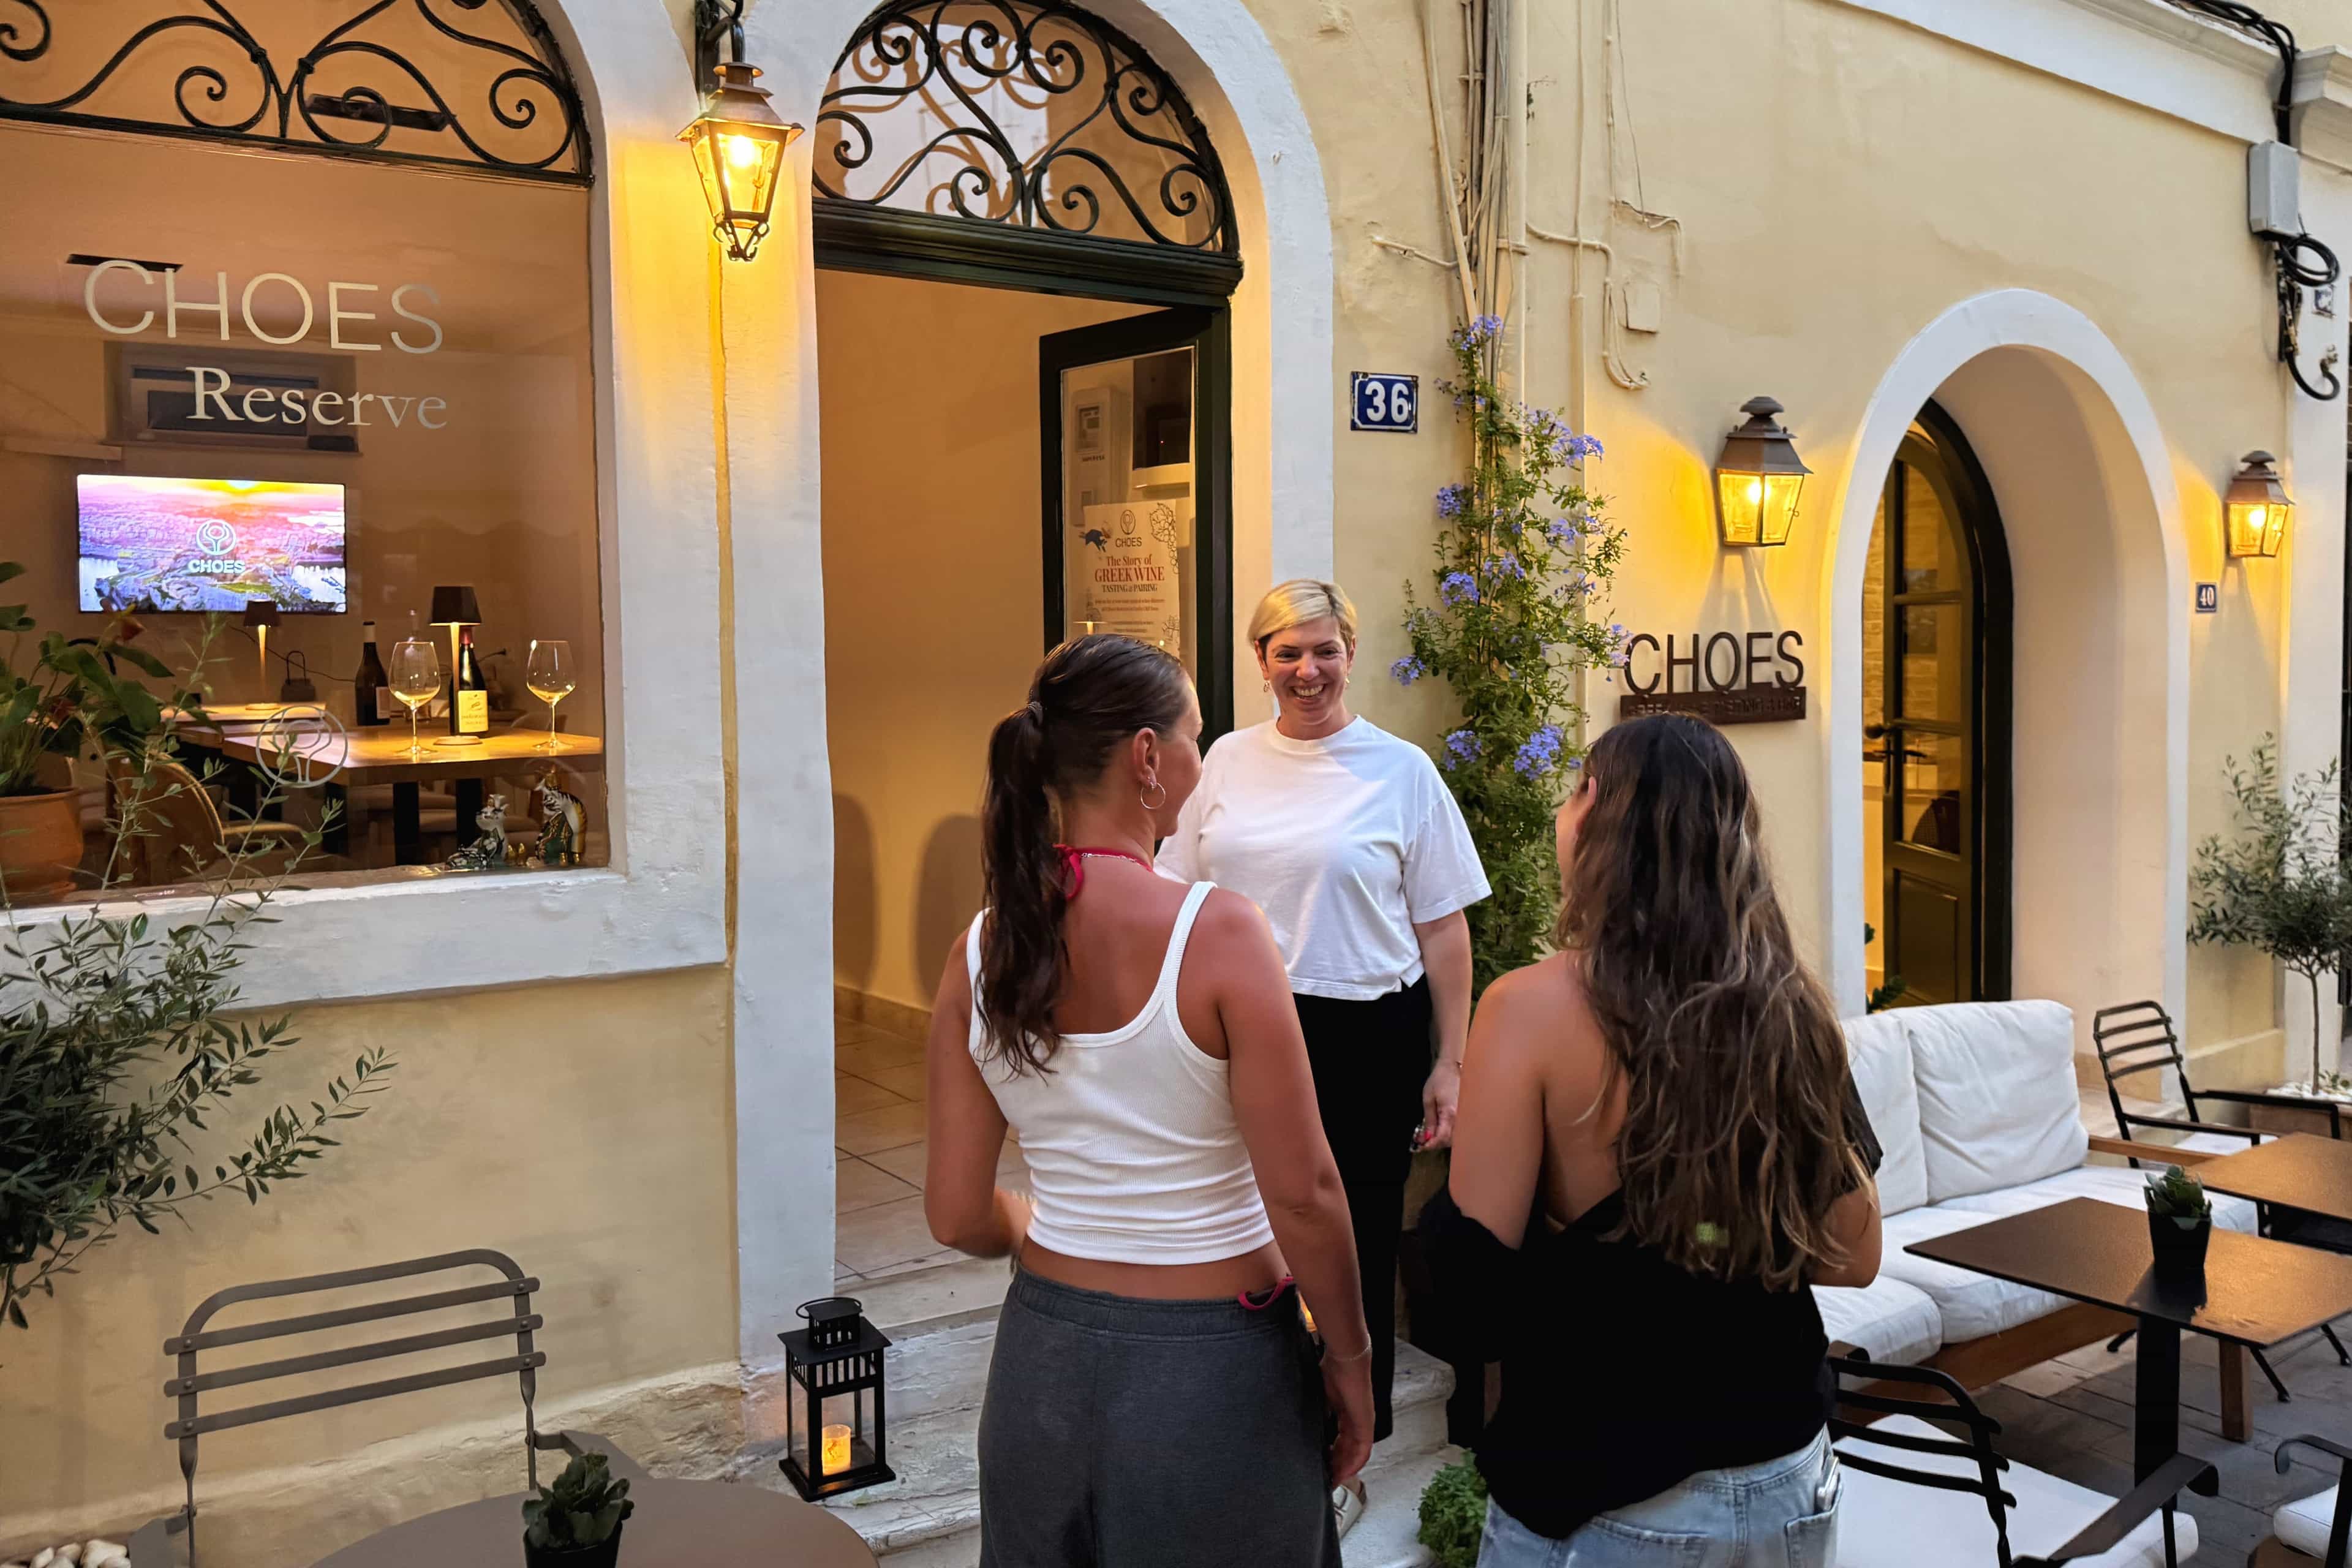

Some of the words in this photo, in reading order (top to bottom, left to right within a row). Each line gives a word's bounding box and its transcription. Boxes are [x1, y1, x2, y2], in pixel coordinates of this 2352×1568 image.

[85, 259, 443, 354] CHOES
[186, 366, 448, 429] Reserve
[1365, 380, 1409, 423] 36
[1115, 537, 1142, 548] CHOES
[187, 559, 246, 573] CHOES
[1107, 555, 1121, 567] The
[1123, 555, 1142, 568] Story
[1144, 553, 1152, 566] of
[1095, 567, 1133, 582] GREEK
[1134, 566, 1165, 582] WINE
[1102, 584, 1128, 593] TASTING
[1134, 583, 1158, 592] PAIRING
[2199, 587, 2215, 606] 40
[1624, 630, 1804, 696] CHOES
